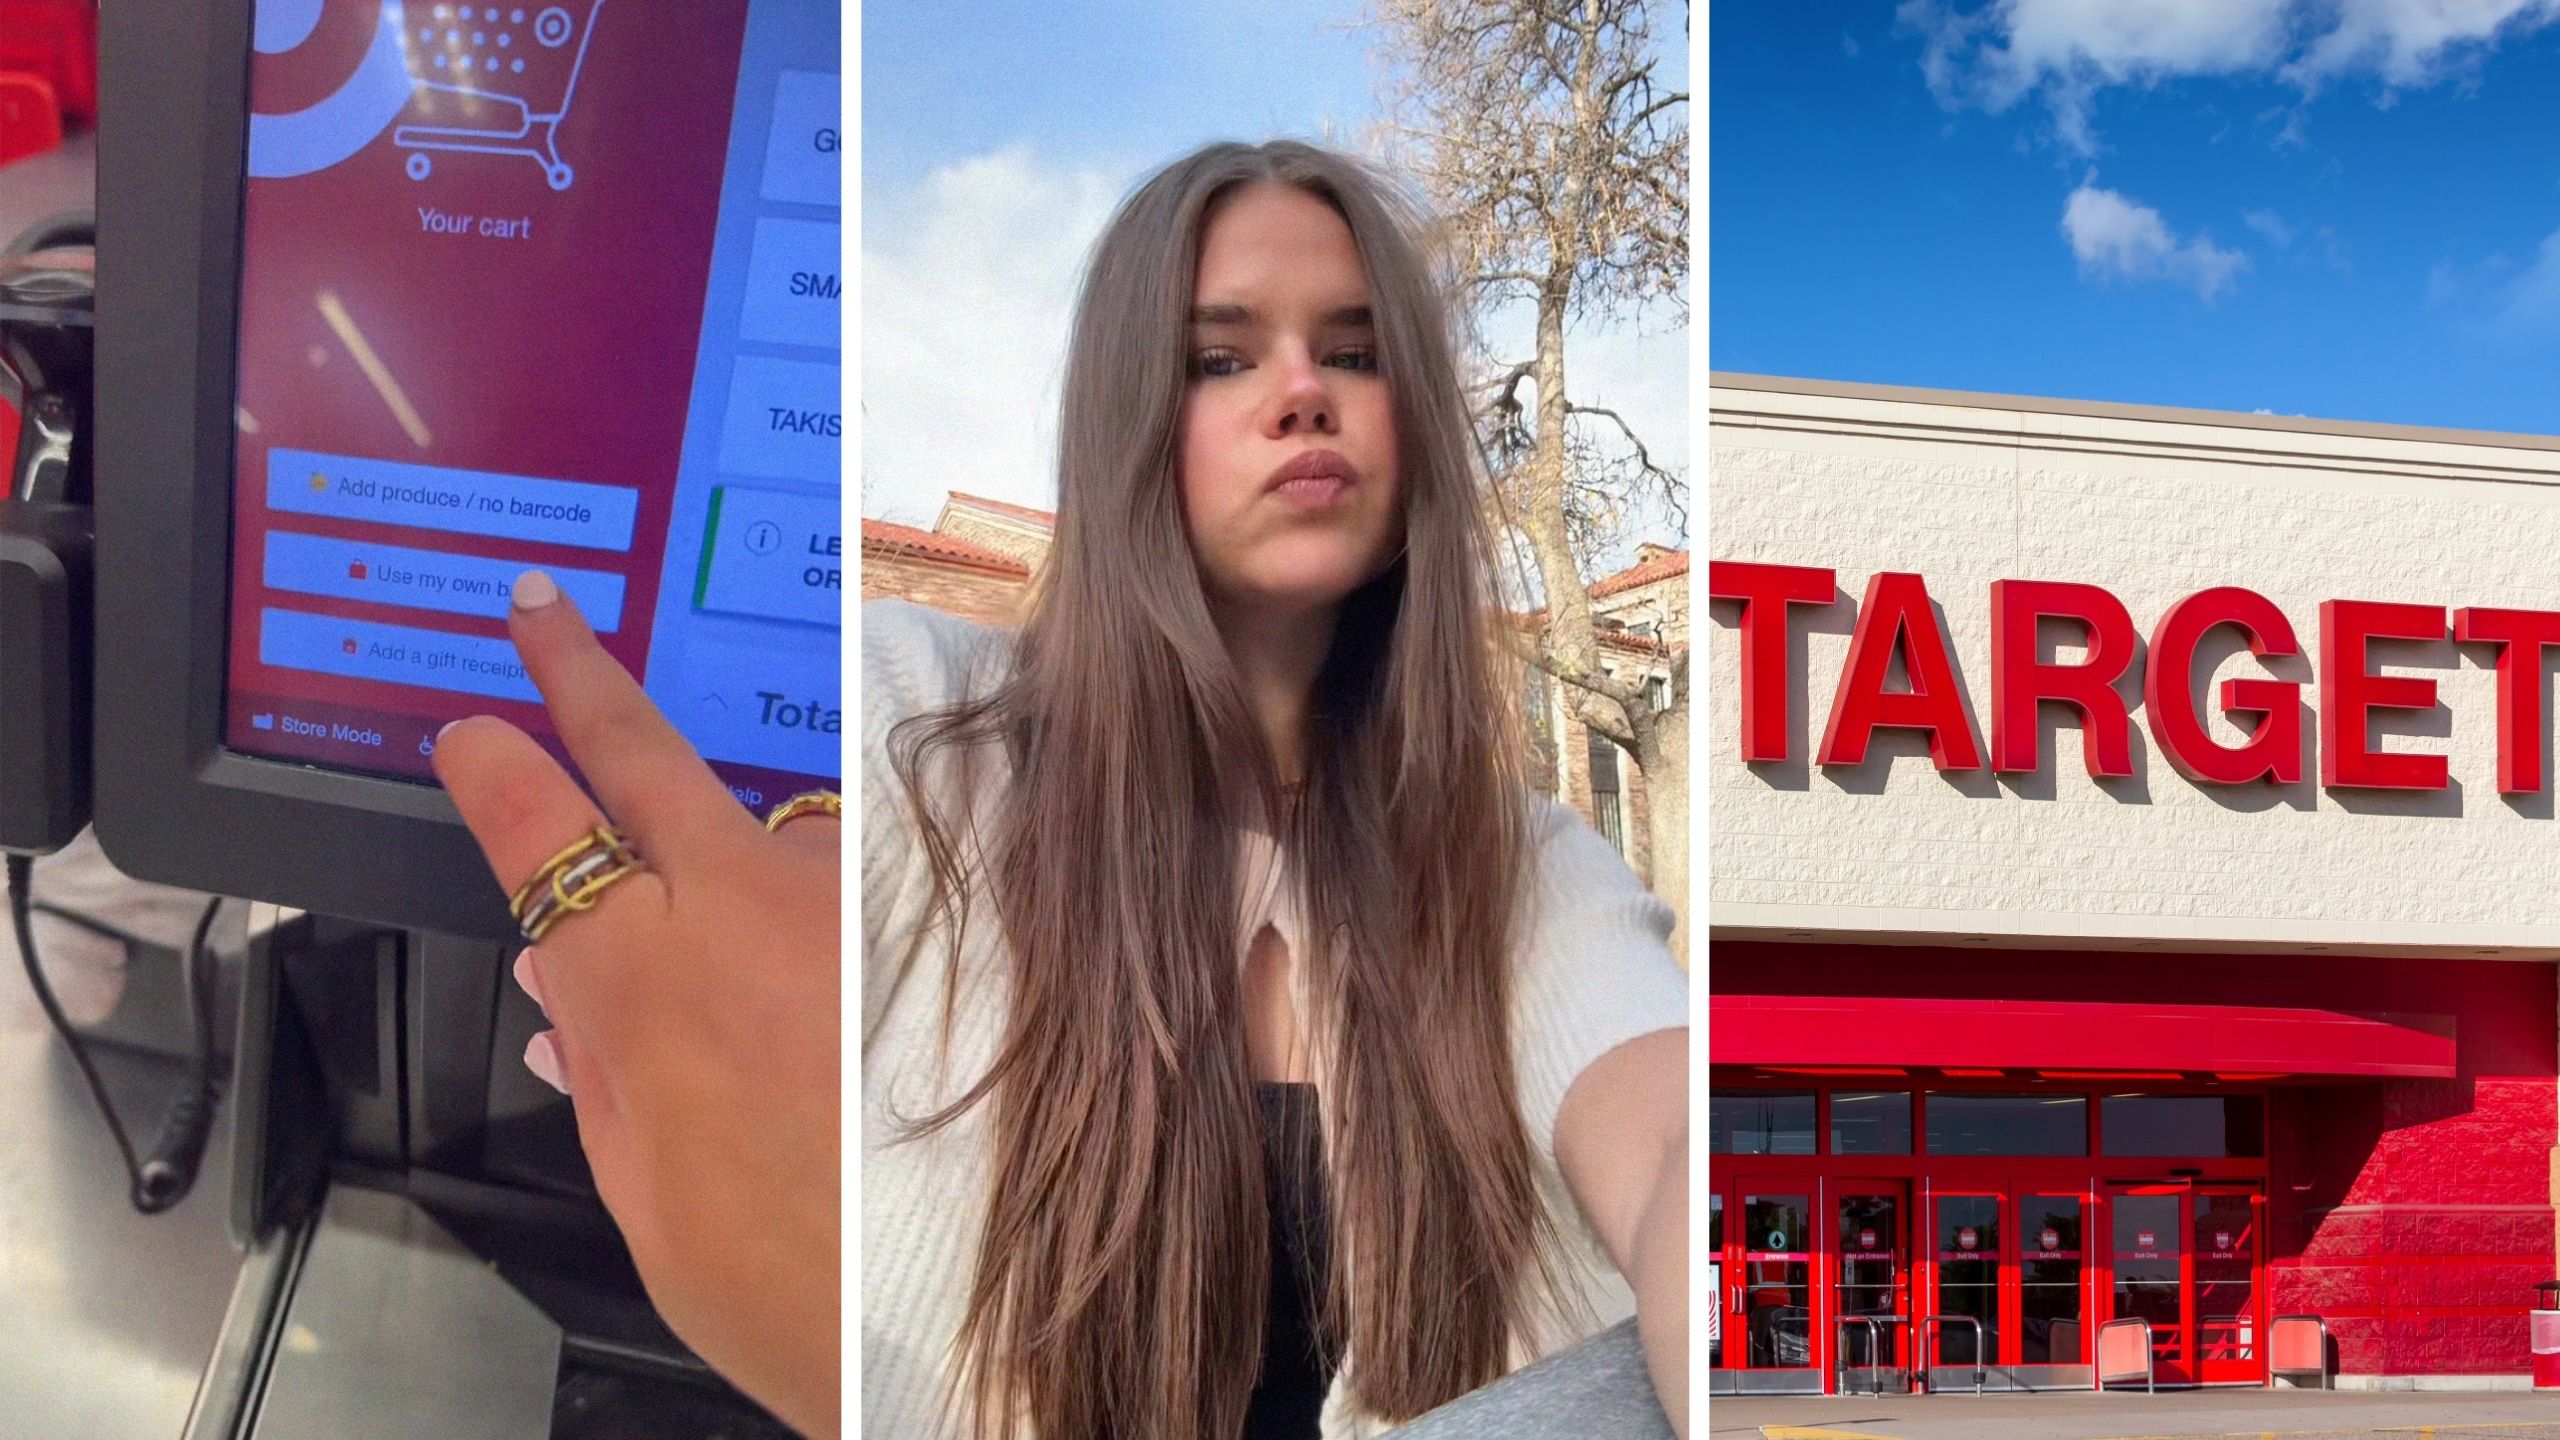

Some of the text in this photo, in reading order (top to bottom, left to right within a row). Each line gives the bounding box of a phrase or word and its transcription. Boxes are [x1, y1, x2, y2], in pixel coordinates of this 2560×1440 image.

[814, 128, 842, 153] G
[418, 207, 533, 239] Your cart
[769, 408, 842, 437] TAKIS
[338, 477, 592, 523] Add produce / no barcode
[809, 533, 842, 557] LE
[377, 564, 412, 585] Use
[419, 573, 448, 593] my
[452, 577, 491, 595] own
[803, 566, 842, 590] OR
[368, 641, 405, 661] Add
[411, 649, 422, 664] a
[428, 650, 457, 670] gift
[1709, 560, 2560, 796] TARGET
[757, 690, 842, 736] Tota
[281, 715, 382, 746] Store Mode
